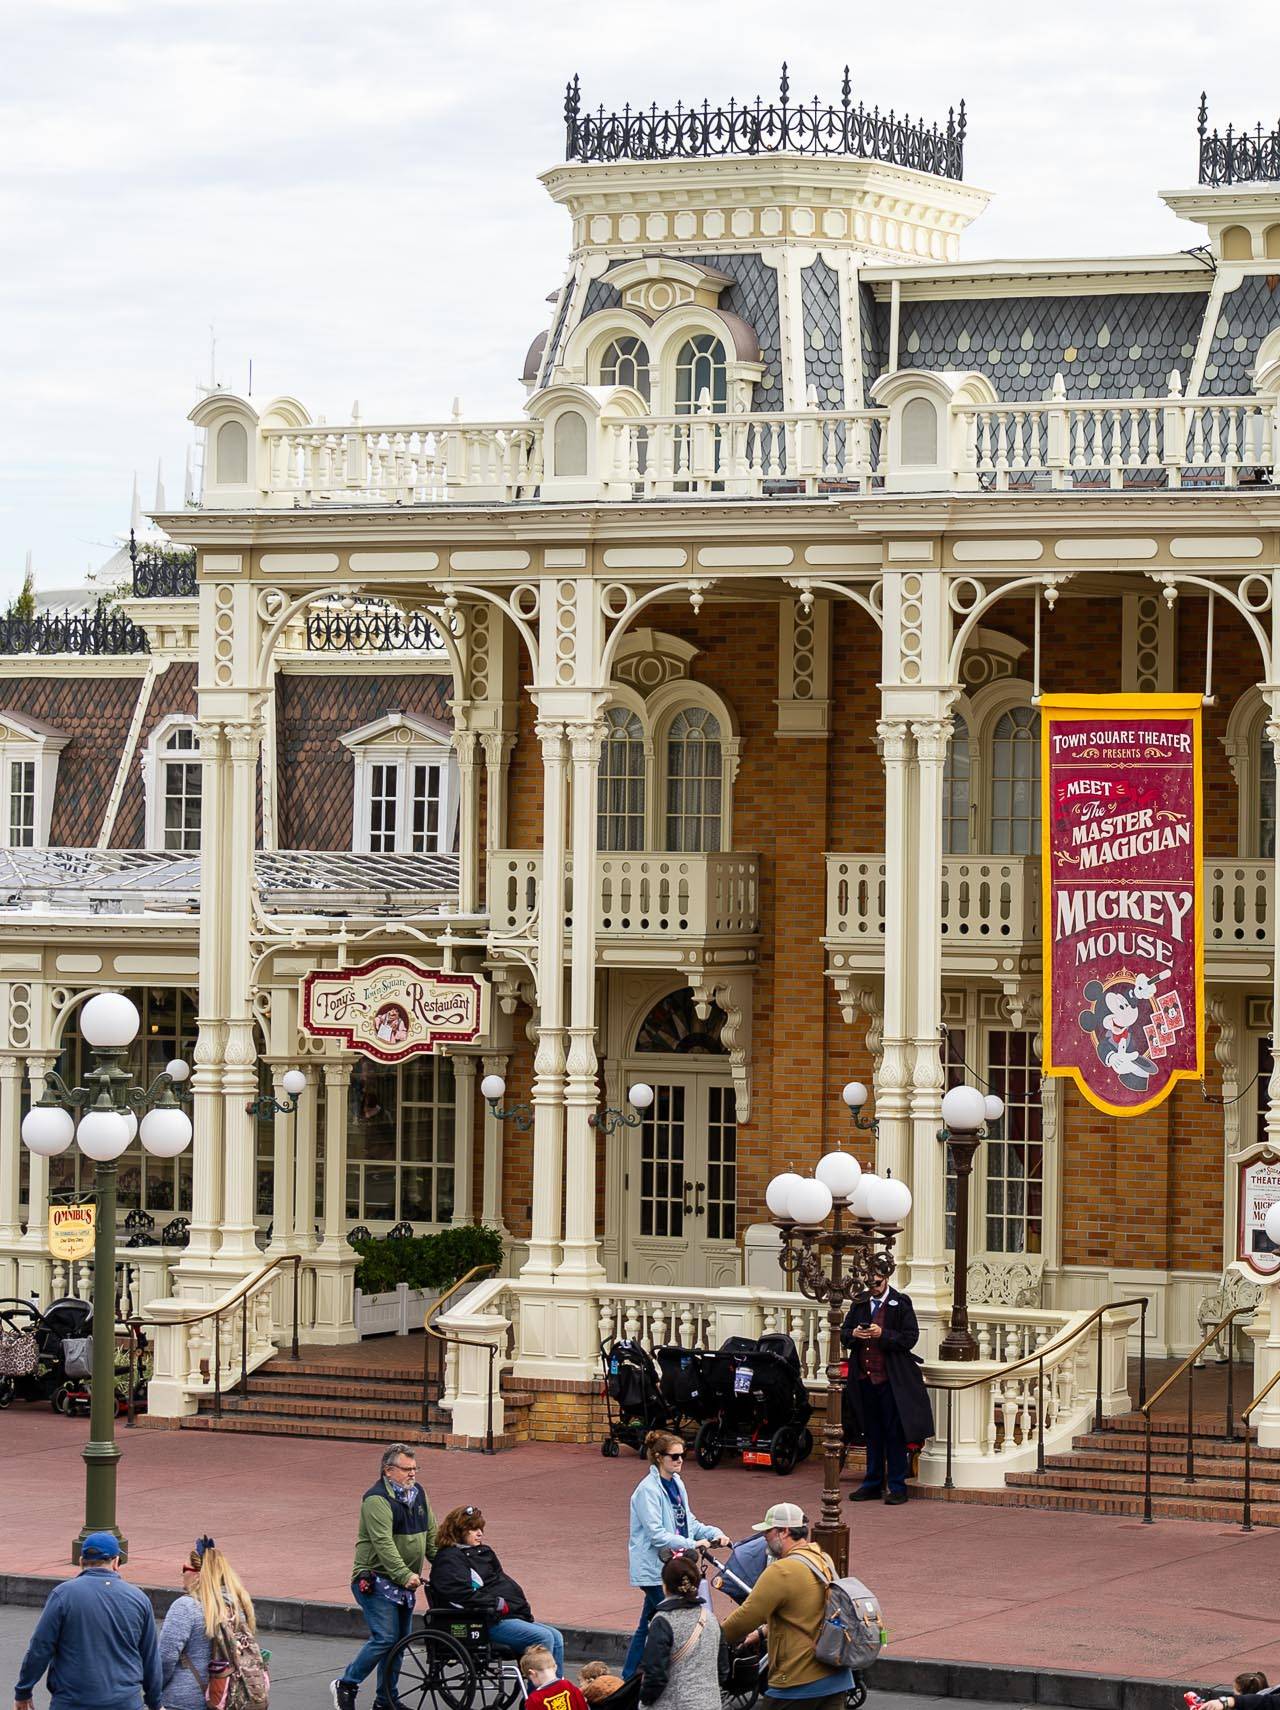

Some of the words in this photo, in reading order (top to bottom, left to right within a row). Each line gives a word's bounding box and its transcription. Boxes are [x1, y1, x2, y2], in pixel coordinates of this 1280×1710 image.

[1053, 733, 1087, 754] TOWN
[1090, 731, 1135, 745] SQUARE
[1138, 731, 1191, 753] THEATER
[1102, 749, 1141, 758] PRESENTS
[1067, 780, 1112, 798] MEET
[1080, 801, 1106, 821] The
[1072, 809, 1153, 846] MASTER
[1079, 822, 1191, 870] MAGICIAN
[1055, 890, 1193, 942] MICKEY
[1075, 932, 1173, 968] MOUSE
[317, 987, 366, 1021] Tony's
[363, 987, 382, 1000] Town
[382, 980, 406, 992] Square
[406, 983, 470, 1025] Restaurant
[54, 1209, 92, 1225] OMNIBUS
[471, 1631, 480, 1639] 19
